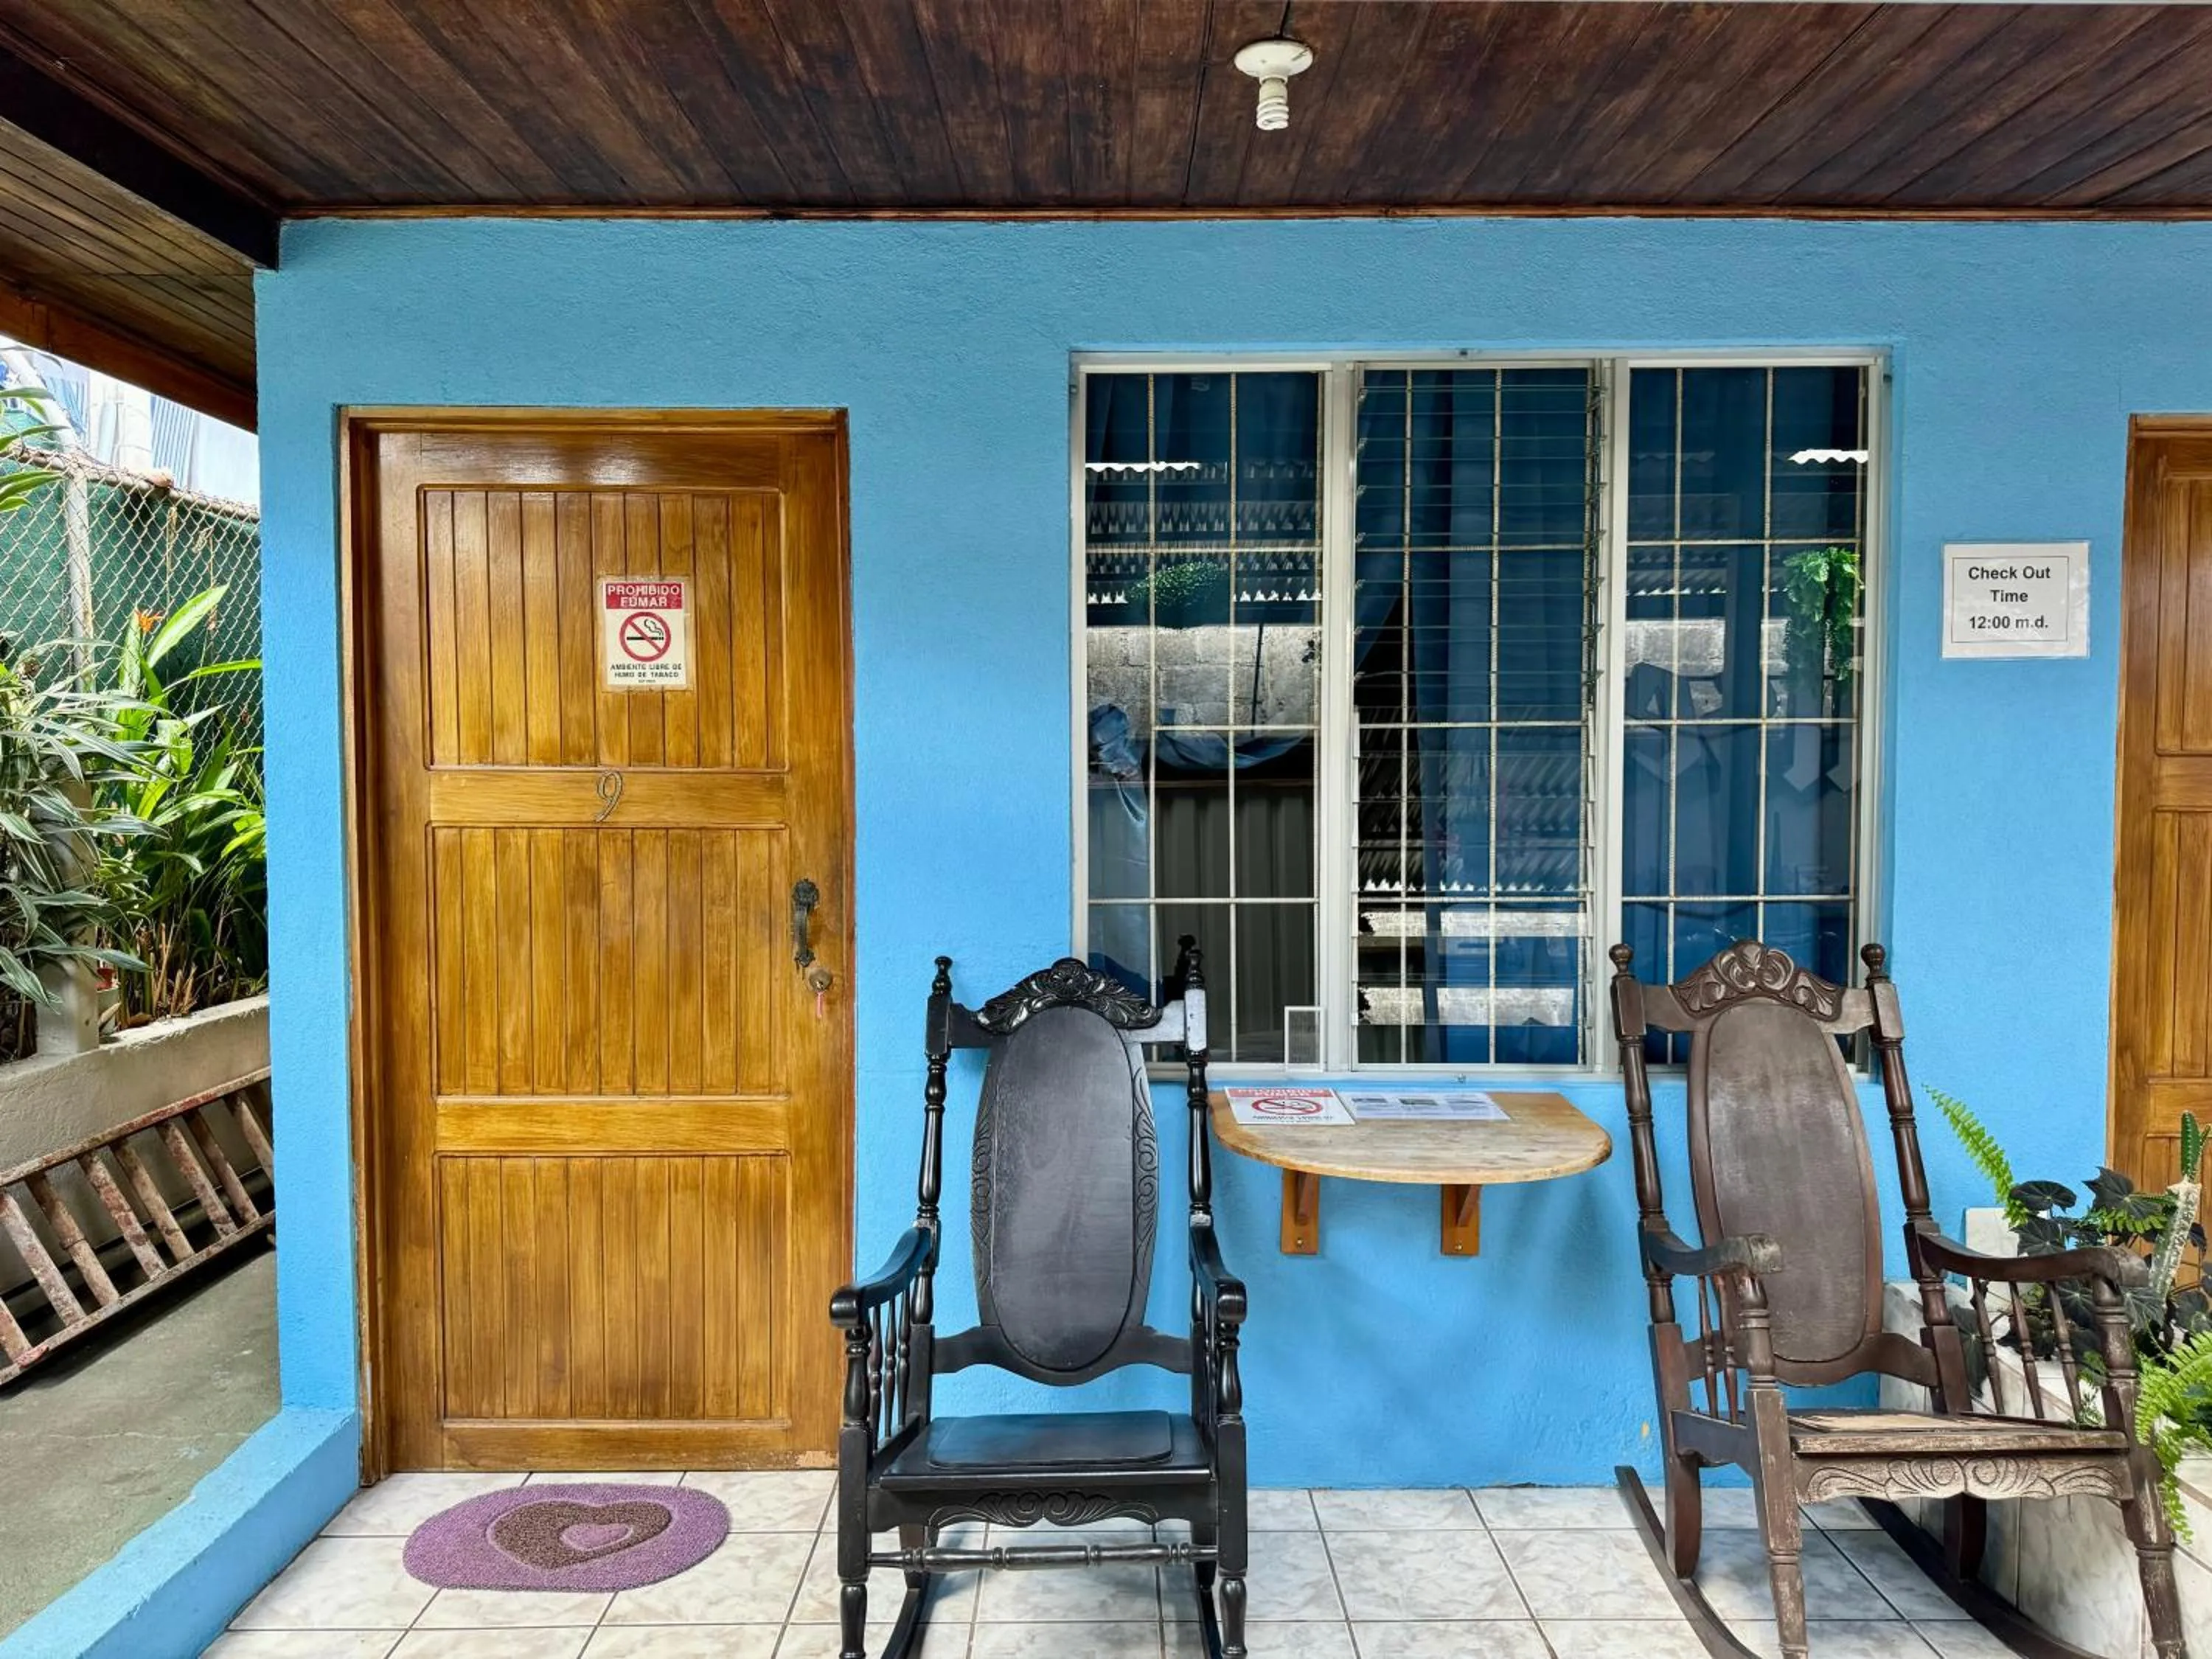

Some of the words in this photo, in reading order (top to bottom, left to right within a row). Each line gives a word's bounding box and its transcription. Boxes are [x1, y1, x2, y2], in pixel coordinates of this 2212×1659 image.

[1968, 566, 2017, 580] Check
[2023, 566, 2051, 579] Out
[608, 585, 679, 595] PROHIBIDO
[1990, 589, 2028, 602] Time
[620, 597, 667, 607] FUMAR
[1969, 616, 2010, 629] 12:00
[2015, 615, 2049, 628] m.d.
[594, 771, 622, 823] 9
